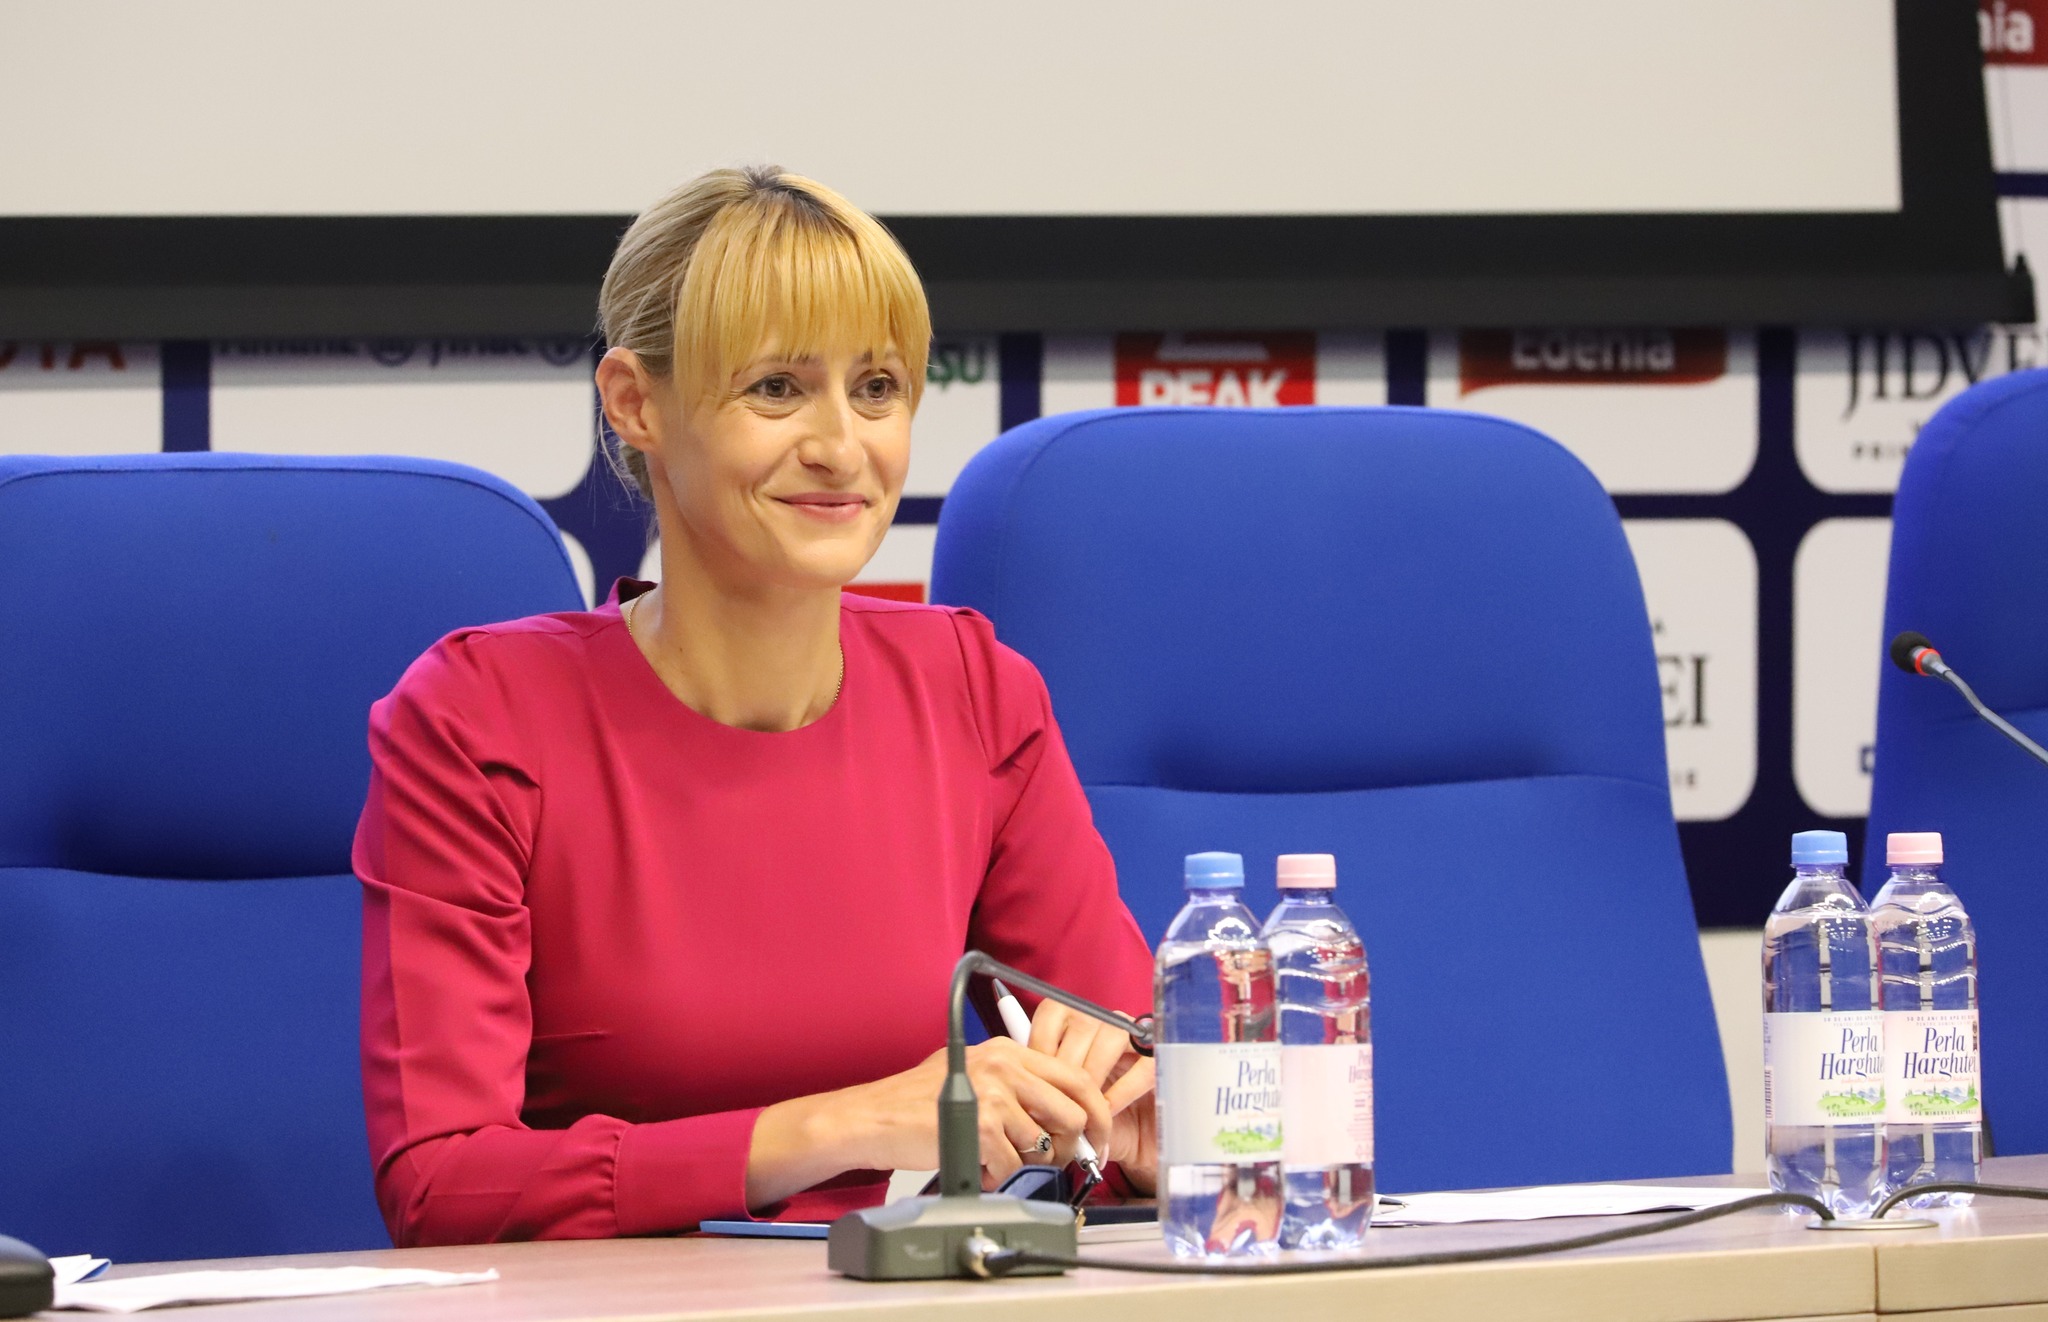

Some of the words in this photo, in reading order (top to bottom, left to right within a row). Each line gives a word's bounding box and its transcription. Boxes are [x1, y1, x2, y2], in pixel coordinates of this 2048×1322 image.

[1139, 368, 1288, 407] PEAK
[1841, 1027, 1877, 1054] Perla
[1924, 1027, 1965, 1053] Perla
[1238, 1059, 1275, 1087] Perla
